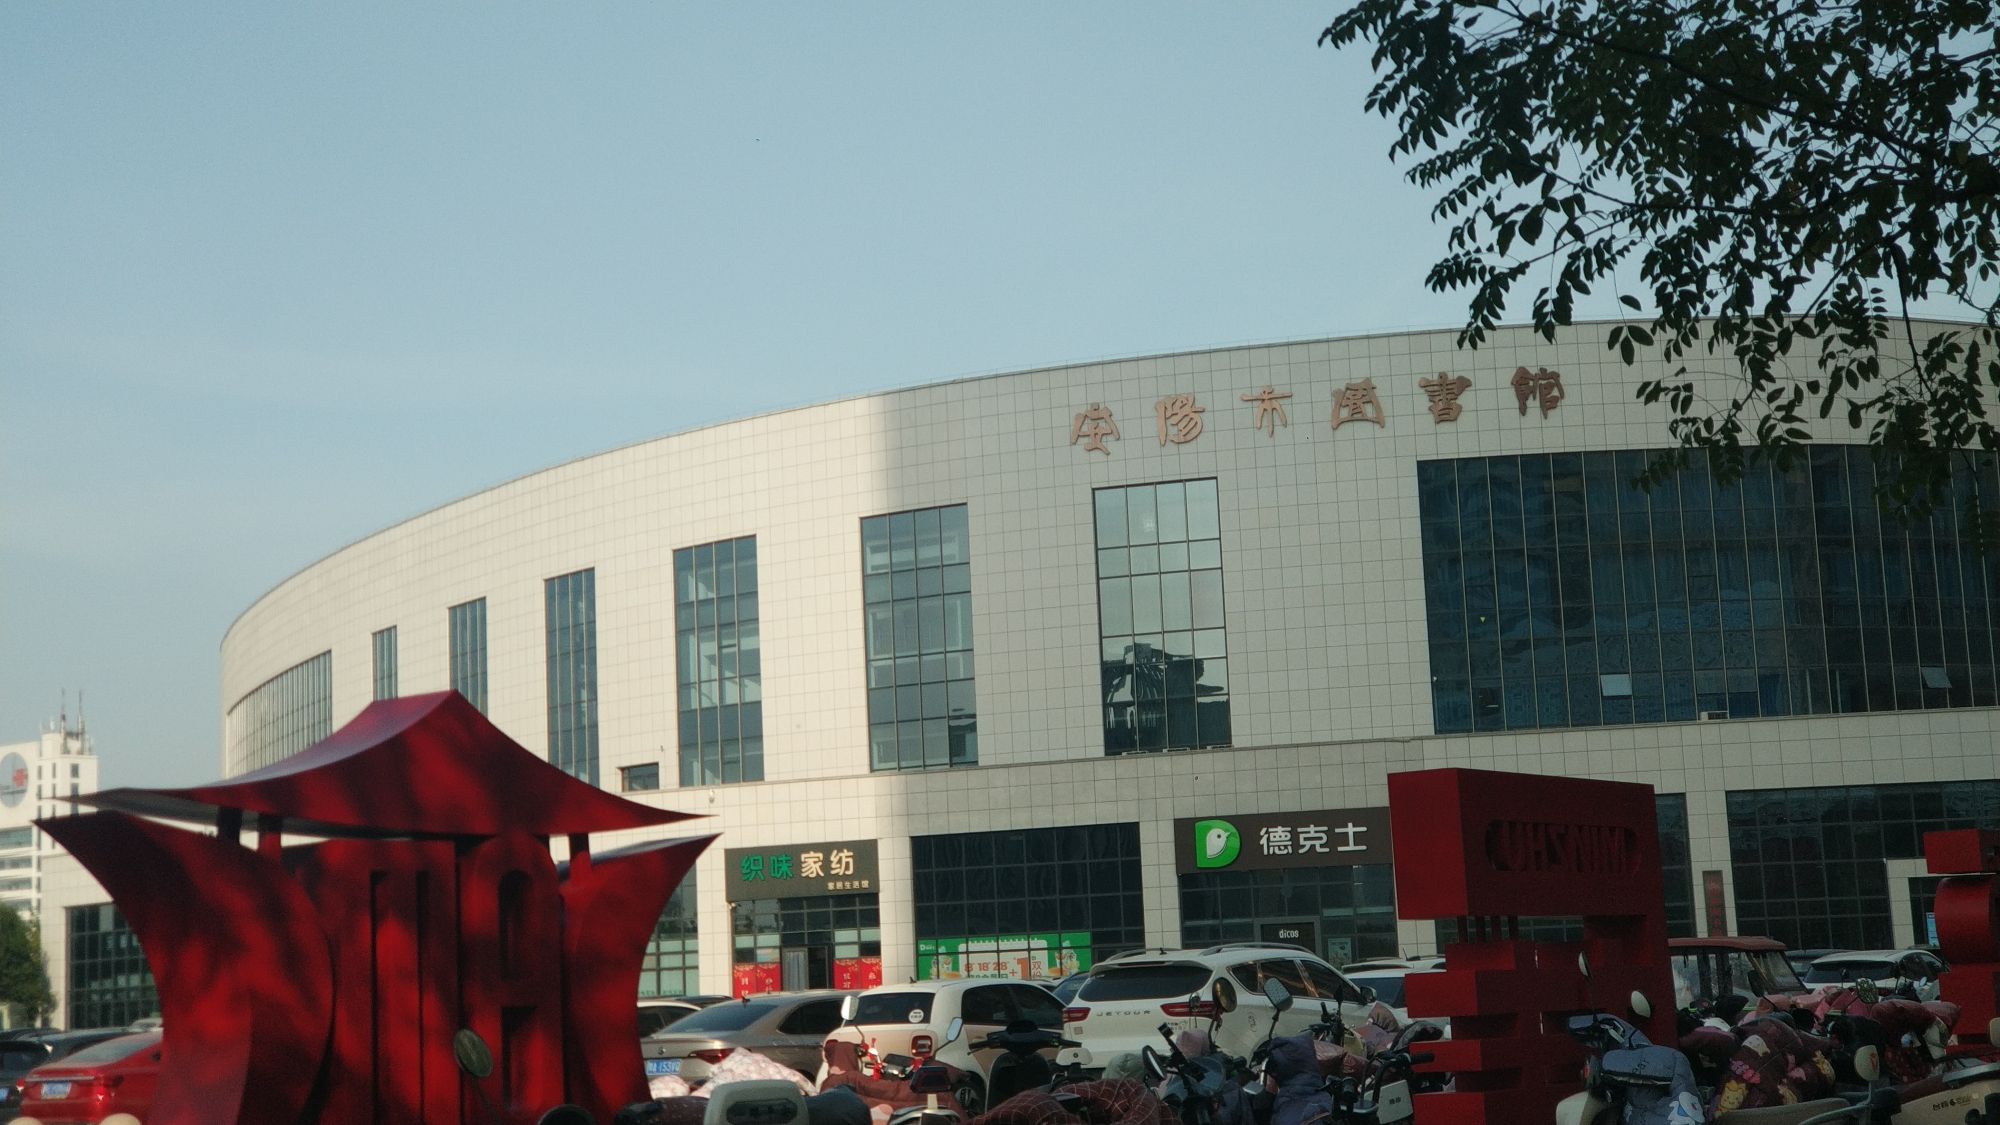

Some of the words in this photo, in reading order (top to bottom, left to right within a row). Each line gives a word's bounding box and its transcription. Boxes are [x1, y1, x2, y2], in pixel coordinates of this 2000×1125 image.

[1259, 822, 1368, 856] 德克士
[741, 849, 854, 881] 织味家纺
[1279, 929, 1299, 939] dicos
